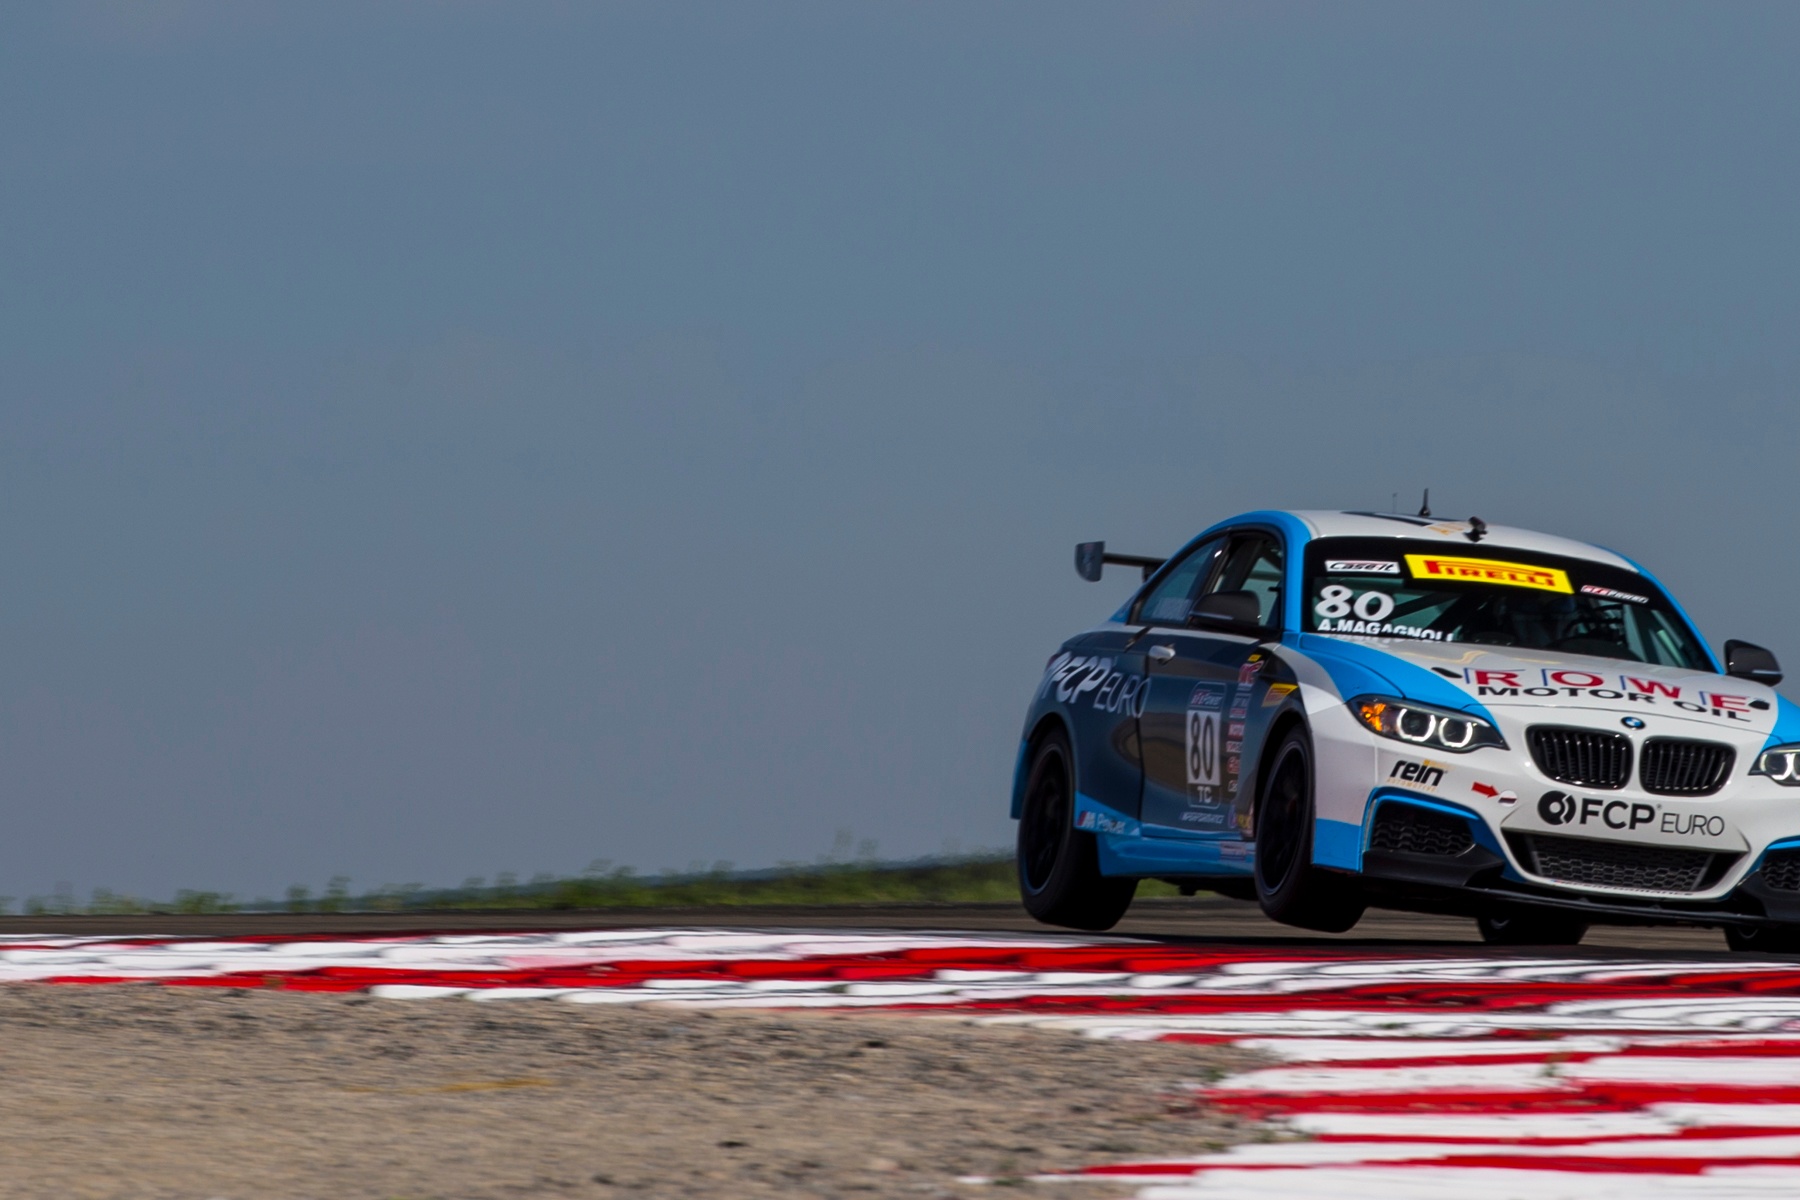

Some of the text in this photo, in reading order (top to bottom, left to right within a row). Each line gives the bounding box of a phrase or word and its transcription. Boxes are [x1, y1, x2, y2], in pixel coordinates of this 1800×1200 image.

[1424, 560, 1555, 587] PIRELLI
[1314, 585, 1395, 621] 80
[1041, 656, 1151, 718] FCP EURO
[1472, 668, 1751, 713] ROWE
[1478, 686, 1752, 722] MOTOR OIL
[1190, 711, 1214, 781] 80
[1390, 759, 1444, 787] rein
[1197, 785, 1213, 804] TC
[1579, 798, 1725, 837] FCP EURO
